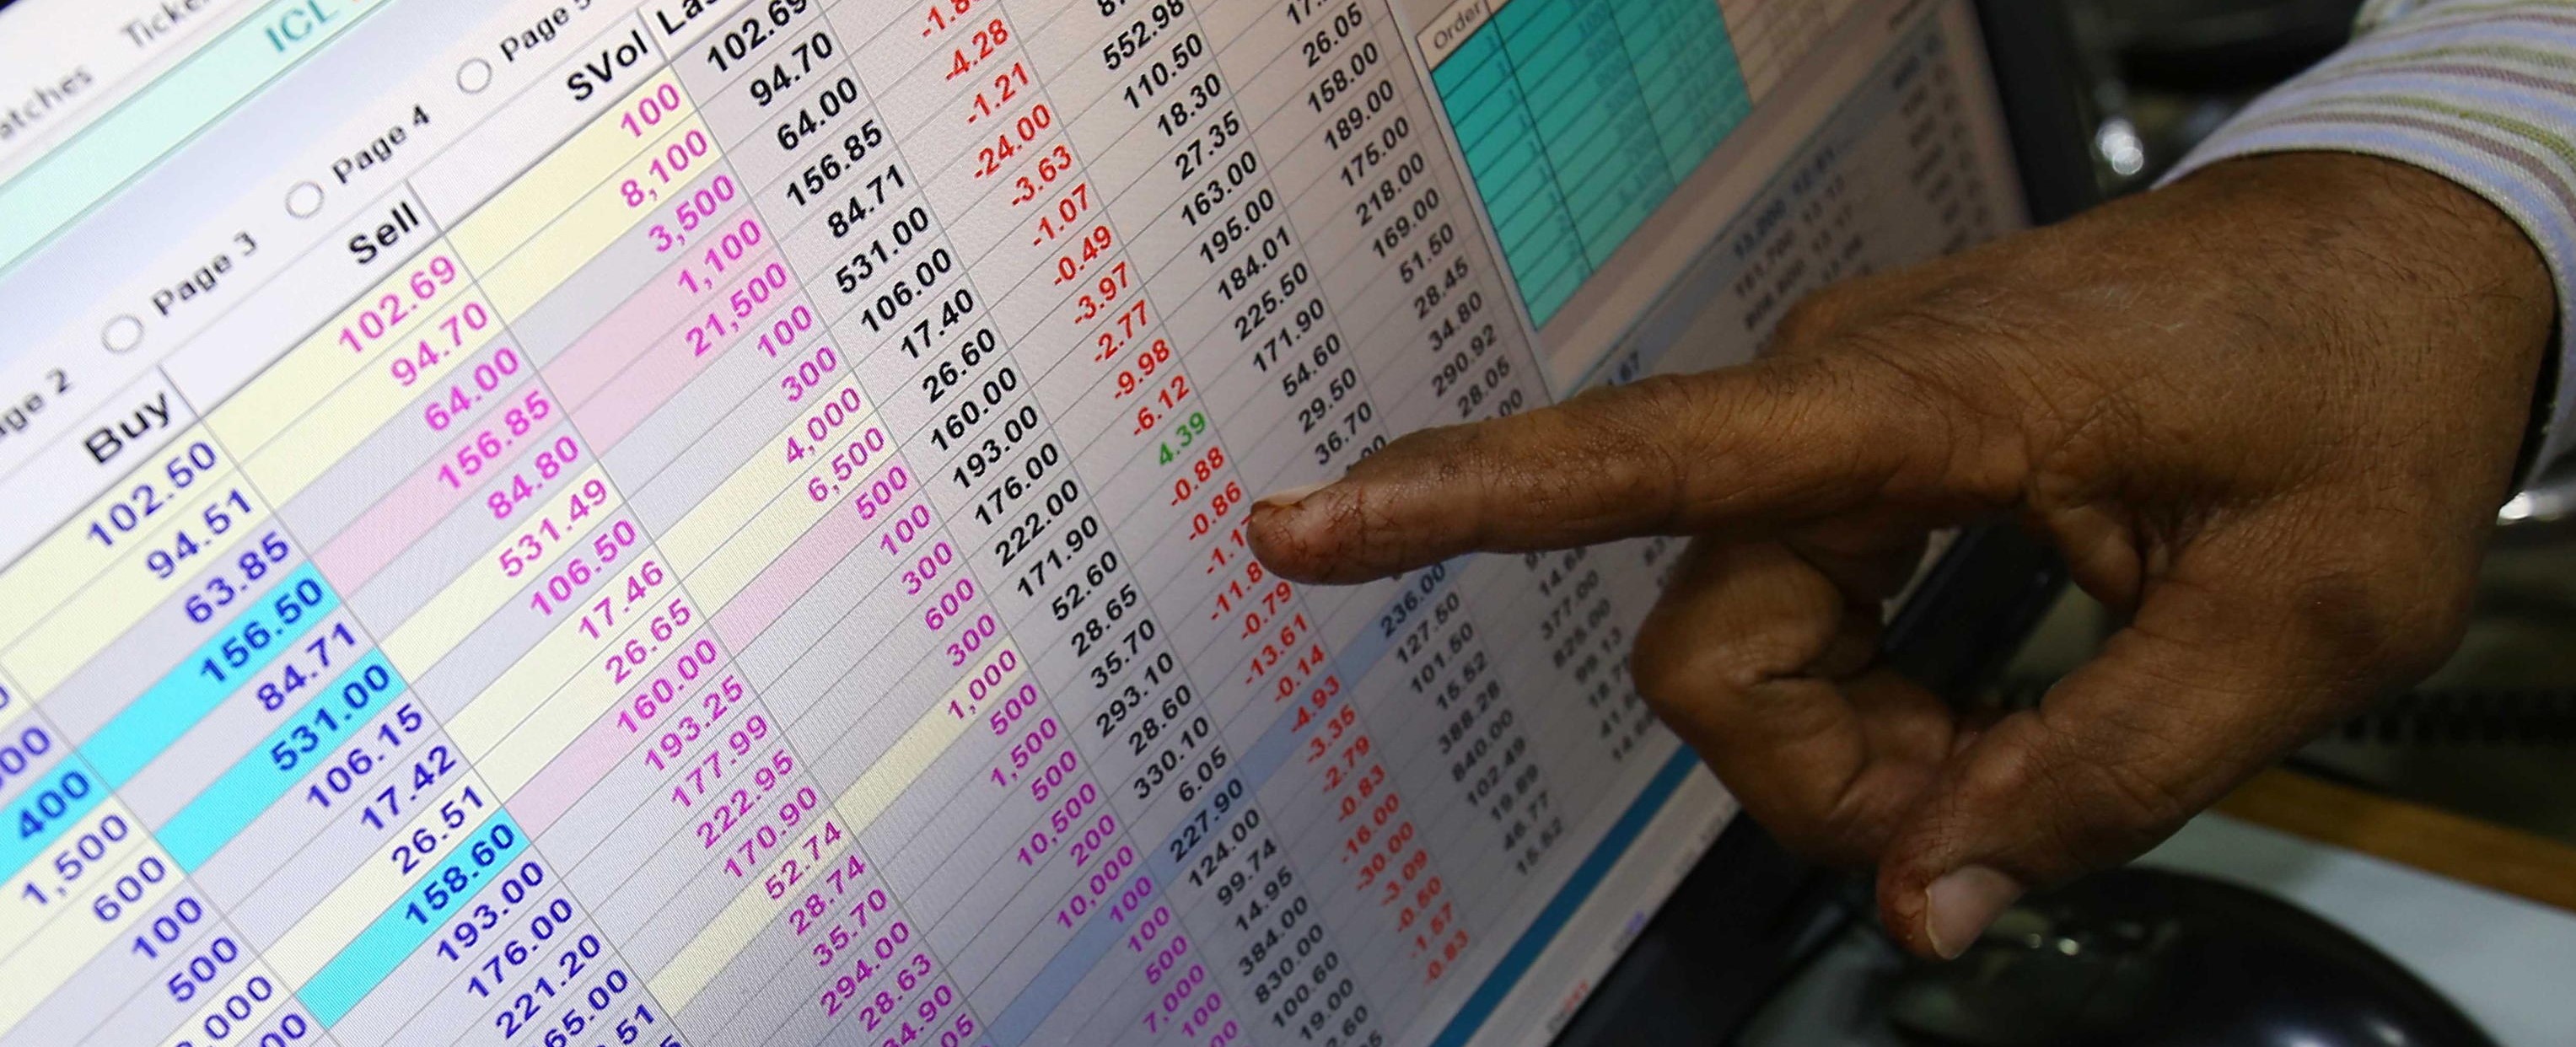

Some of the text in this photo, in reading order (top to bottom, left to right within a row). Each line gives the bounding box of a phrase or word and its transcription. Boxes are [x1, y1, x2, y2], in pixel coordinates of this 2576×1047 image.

[48, 7, 569, 395] 2 Page 3 Page 4 Page
[83, 29, 648, 464] Buy Sell SVol
[88, 0, 807, 545] 102.50 102.69 100 102.69
[264, 0, 340, 52] ICL
[1433, 3, 1482, 49] Order
[19, 18, 1008, 839] 400 156.50 156.85 1,100 156.85 -4.28
[22, 62, 1028, 905] 1,500 84.71 84.80 21,500 84.71 -1.21
[92, 0, 1184, 922] 600 531.00 531.49 100 531.00 -24.00 552.98
[132, 32, 1202, 958] 100 106.15 106.50 300 106.00 -3.63 110.50
[146, 31, 832, 578] 94.51 94.70 8,100 94.70
[167, 72, 1221, 1002] 500 17.42 17.46 4,000 17.40 -1.07 18.30
[184, 76, 858, 623] 63.85 64.00 3,500 64.00
[390, 1, 1362, 875] 26.51 26.65 6,500 26.60 -0.49 27.35 26.05
[405, 41, 1378, 924] 158.60 160.00 500 160.00 -3.97 163.00 158.00
[437, 78, 1394, 961] 193.00 193.25 100 193.00 -2.77 195.00 189.00
[467, 115, 1409, 997] 176.00 177.99 300 176.00 -9.98 184.01 175.00
[723, 187, 1439, 878] 170.90 300 171.90 4.39 171.90 169.00
[764, 222, 1454, 900] 52.74 1,000 52.60 -0.88 54.60 51.50
[495, 151, 1424, 1039] 221.20 222.95 600 222.00 -6.12 225.50 218.00
[788, 255, 1468, 936] 28.74 500 28.65 -0.86 29.50 28.45
[812, 290, 1482, 967] 35.70 1,500 35.70 36.70 34.80
[820, 323, 1497, 1017] 294.00 500 293.10 290.92
[858, 355, 1510, 1033] 28.63 10,500 28.60 -0.79 28.05
[1057, 643, 1324, 928] 10,000 6.05 -0.14
[1069, 613, 1307, 867] 200 330.10 -13.61
[1109, 561, 1445, 922] 100 227.90 -4.93 236.00
[1127, 905, 1170, 953] 100
[1188, 808, 1260, 887] 124.00
[1142, 964, 1204, 1033] 7,000
[1235, 865, 1293, 931] 14.95
[1144, 935, 1186, 985] 500
[1216, 837, 1277, 906] 99.74
[1181, 991, 1221, 1038] 100
[1238, 895, 1308, 976] 384.00
[1254, 923, 1323, 1004] 830.00
[1272, 950, 1338, 1028] 100.60
[1300, 977, 1353, 1040] 19.00
